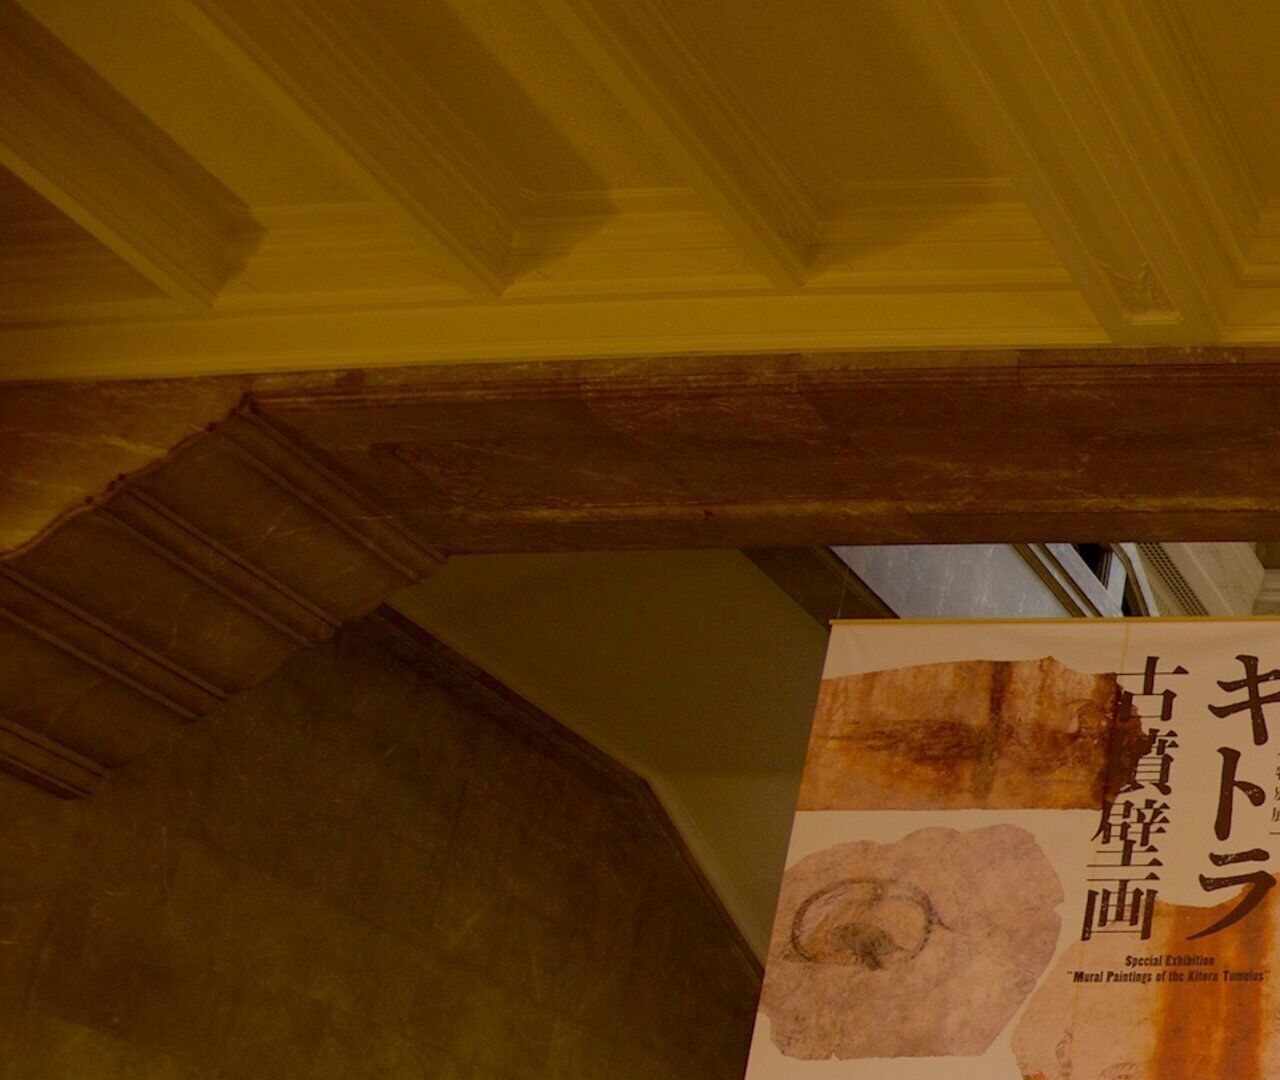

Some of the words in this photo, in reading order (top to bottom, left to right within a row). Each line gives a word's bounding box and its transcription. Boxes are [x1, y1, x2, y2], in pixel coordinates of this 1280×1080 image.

[1080, 655, 1190, 941] 古墳壁画
[1125, 954, 1163, 968] Special
[1165, 954, 1216, 967] Exhibition
[1106, 970, 1152, 984] Paintings
[1155, 969, 1166, 983] of
[1168, 969, 1184, 983] the
[1187, 969, 1219, 983] Kitora
